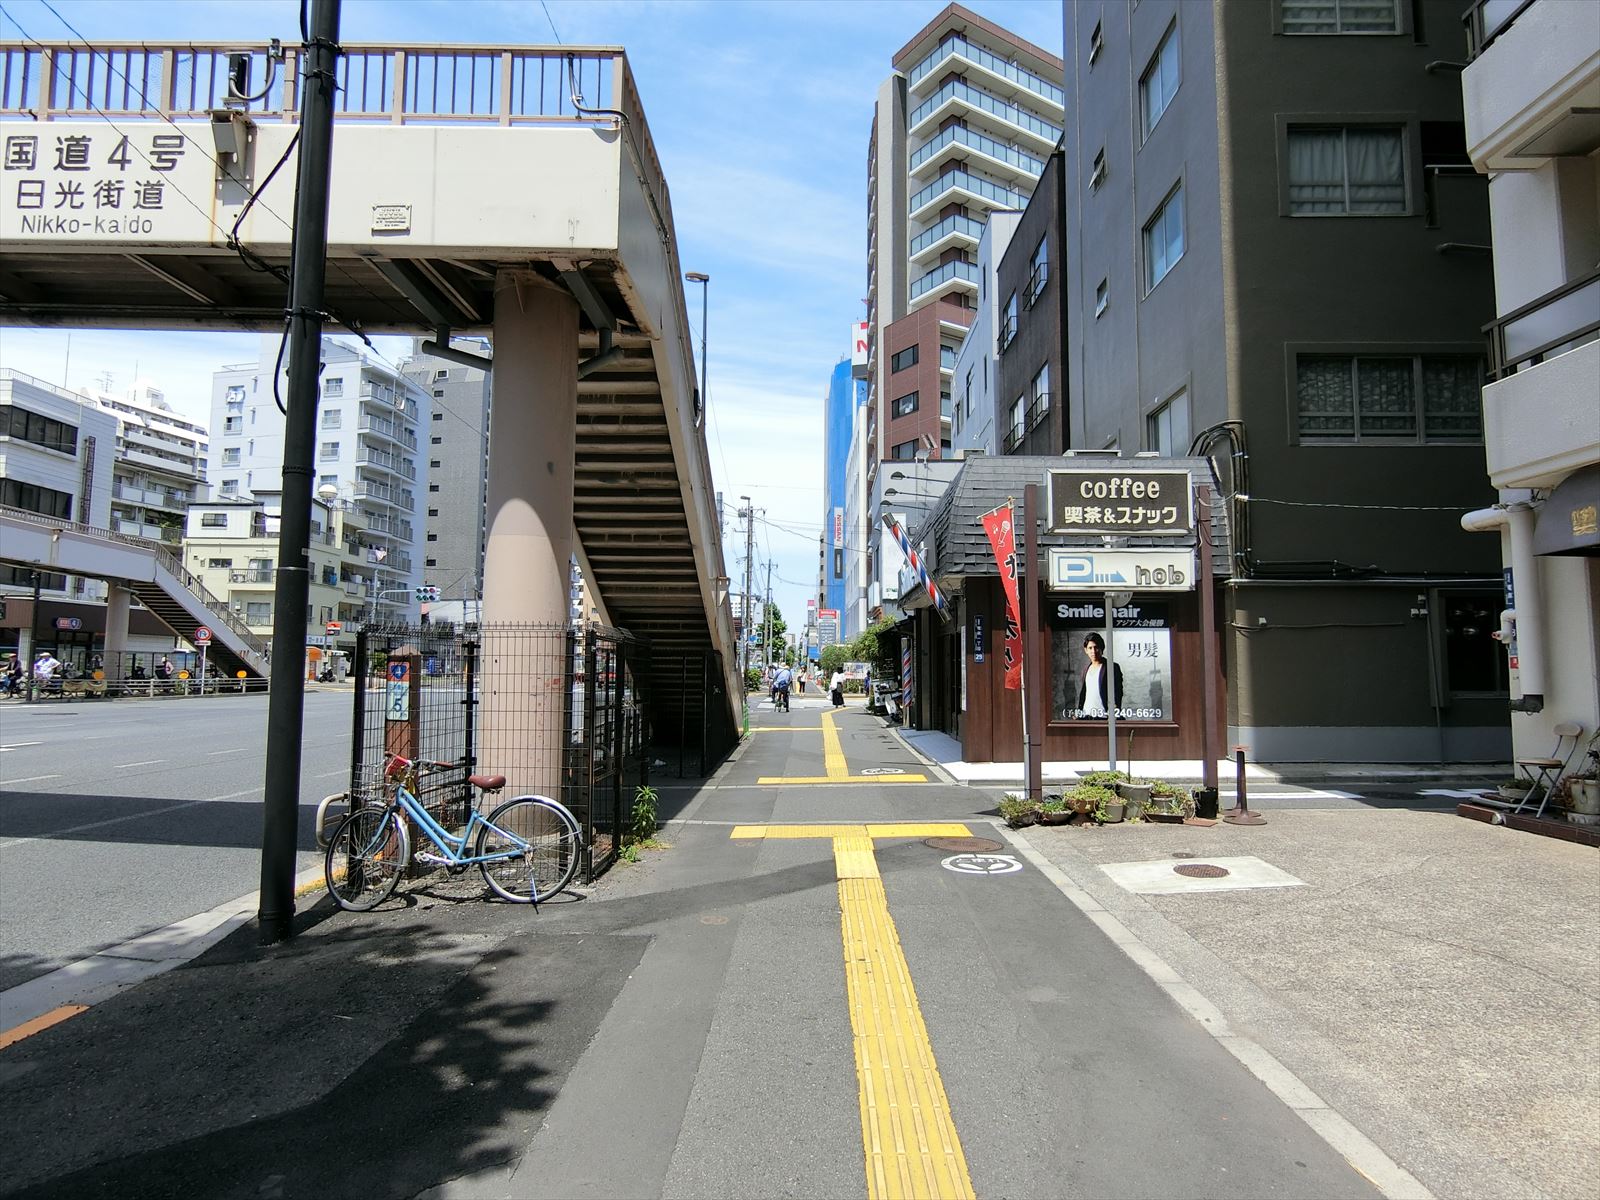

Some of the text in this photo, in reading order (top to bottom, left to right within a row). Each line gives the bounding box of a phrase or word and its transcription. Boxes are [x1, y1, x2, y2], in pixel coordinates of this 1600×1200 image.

[4, 135, 185, 171] 国道4号
[17, 180, 165, 209] 日光街道
[21, 214, 153, 234] Nikko-kaido
[1080, 478, 1160, 499] coffee
[1064, 506, 1177, 524] 喫茶&スナック
[1135, 564, 1185, 585] hob
[1057, 604, 1105, 618] Smile
[1128, 642, 1159, 658] 男髪
[393, 698, 402, 712] 5
[1091, 709, 1162, 718] 03-240-6629
